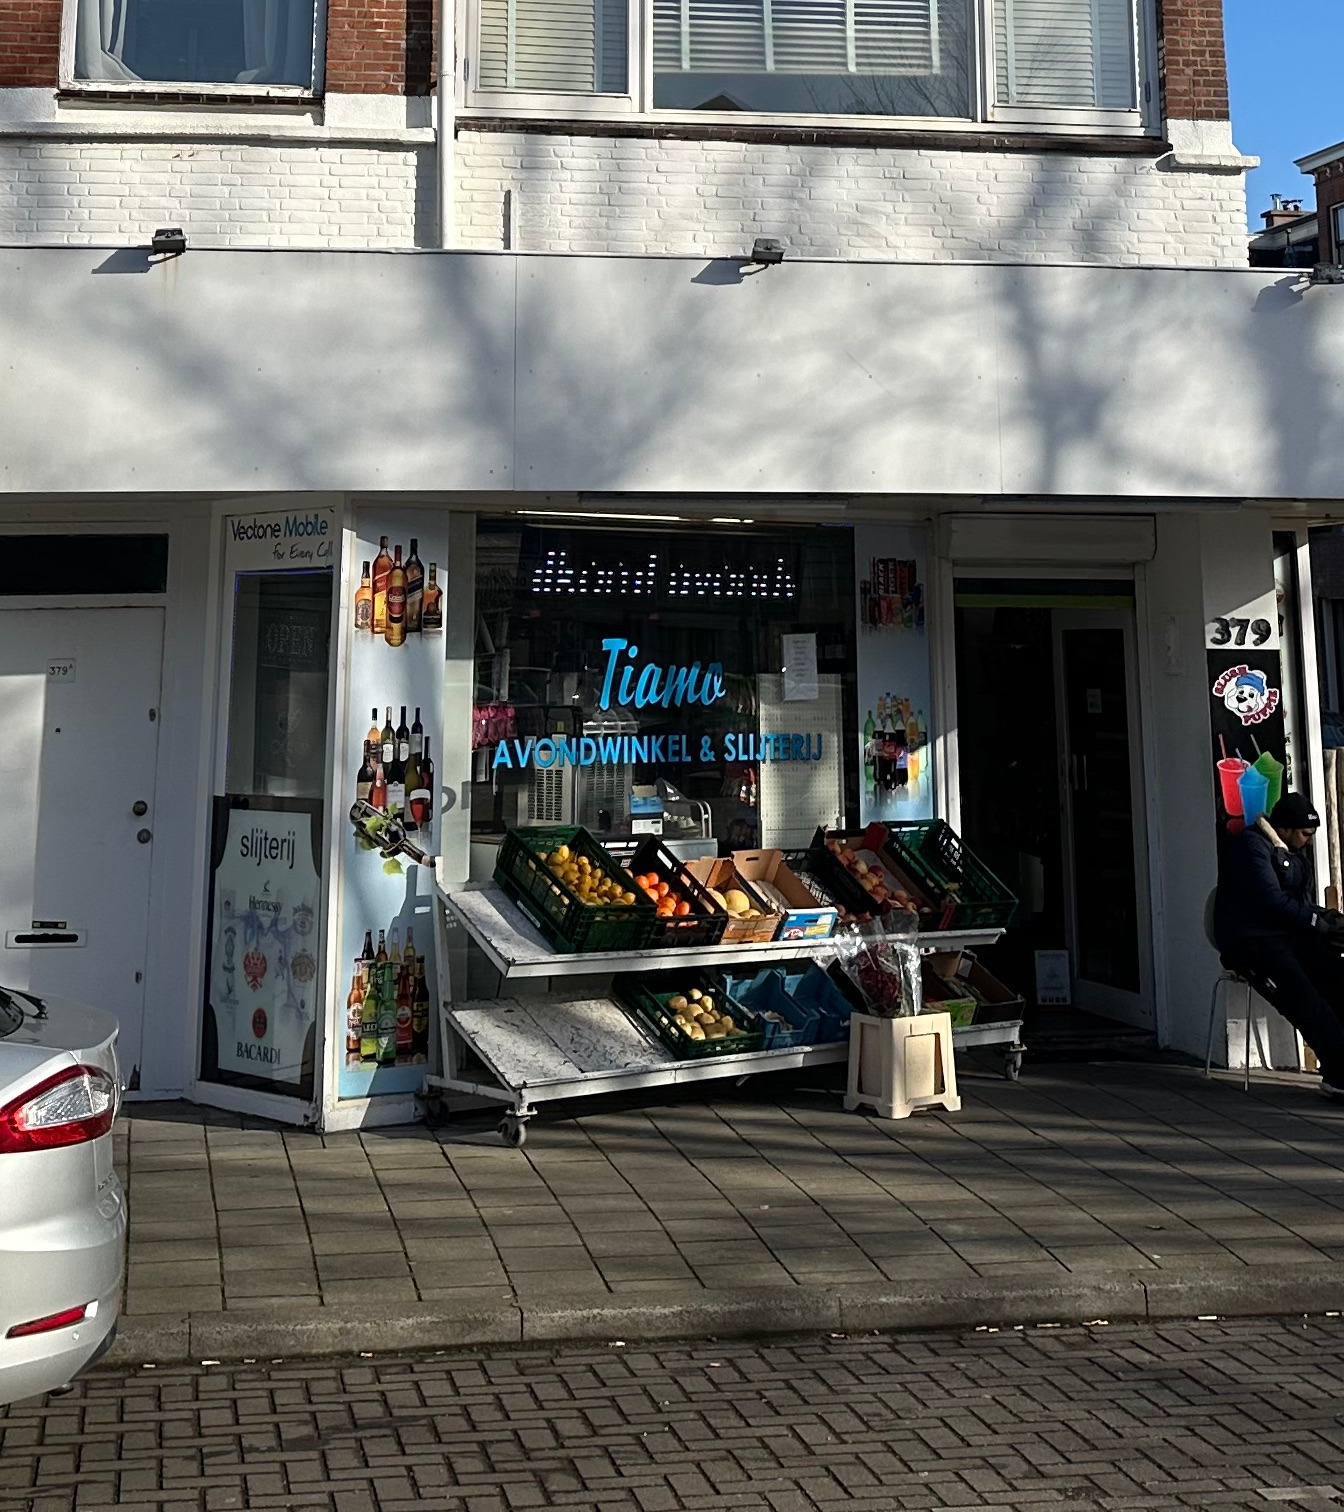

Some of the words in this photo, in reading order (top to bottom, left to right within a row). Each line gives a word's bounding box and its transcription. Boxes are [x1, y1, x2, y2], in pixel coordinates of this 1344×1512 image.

[231, 517, 281, 541] Vectone
[283, 513, 329, 538] Mobile
[1210, 617, 1272, 646] 379
[599, 638, 726, 711] Tiamo
[492, 735, 691, 769] AVONDWINKEL
[700, 739, 716, 762] &
[724, 732, 823, 762] SLIJTERIJ
[240, 828, 296, 869] slijterij
[236, 1041, 281, 1065] BACARDI
